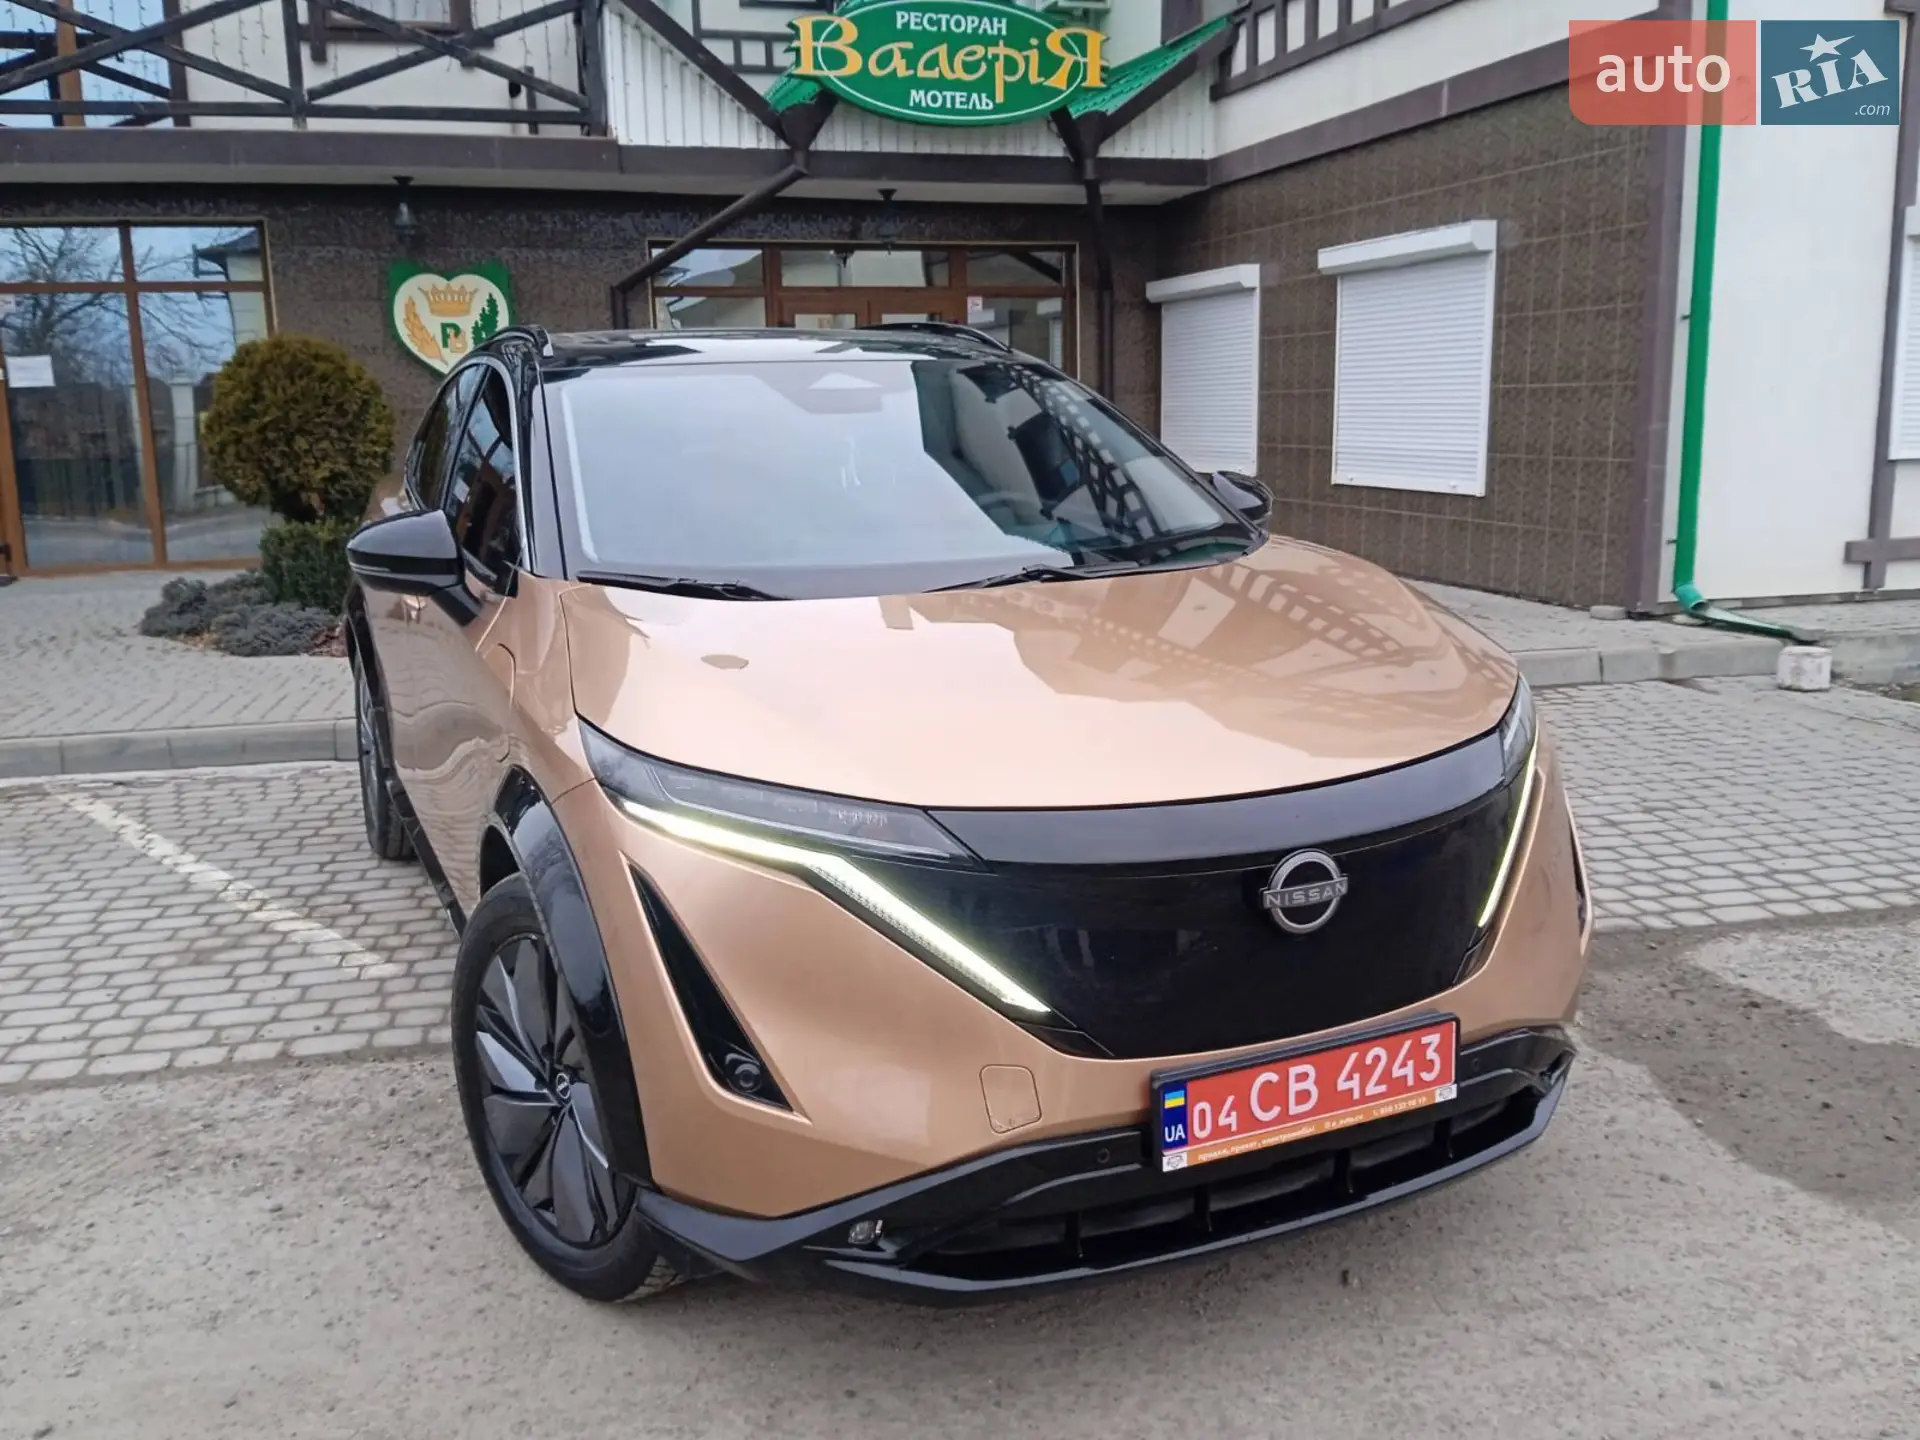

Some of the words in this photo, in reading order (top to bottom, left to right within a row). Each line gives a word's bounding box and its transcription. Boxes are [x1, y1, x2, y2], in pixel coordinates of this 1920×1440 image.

[896, 10, 1007, 36] РЕСТОРАН
[909, 89, 994, 110] МОТЕЛЬ
[1265, 881, 1347, 908] NISSAN
[1192, 1095, 1238, 1139] 04
[1336, 1032, 1441, 1100] 4243
[1164, 1124, 1186, 1143] UA
